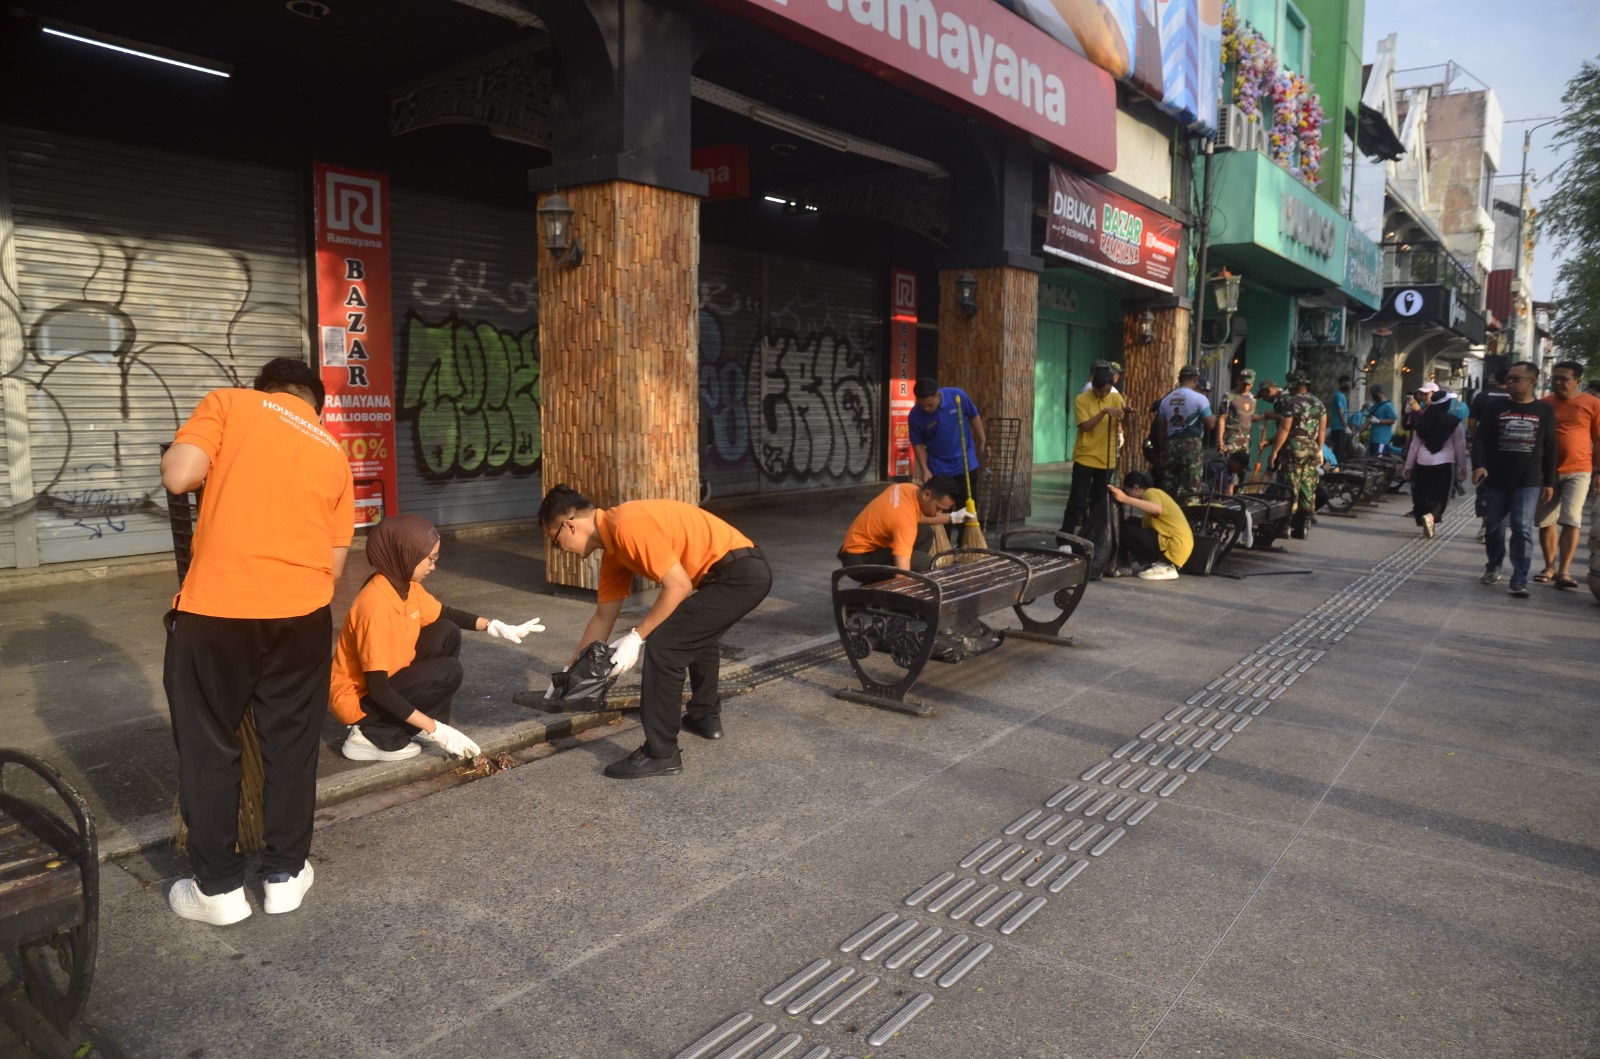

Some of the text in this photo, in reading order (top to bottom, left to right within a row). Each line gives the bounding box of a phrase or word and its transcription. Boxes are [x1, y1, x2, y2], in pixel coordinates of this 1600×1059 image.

[1053, 190, 1097, 230] DIBUKA
[1101, 202, 1143, 247] BAZAR
[326, 232, 382, 248] Ramayana
[344, 257, 369, 387] BAZAR
[325, 395, 391, 408] RAMAYANA
[326, 413, 391, 422] MALIOBORO
